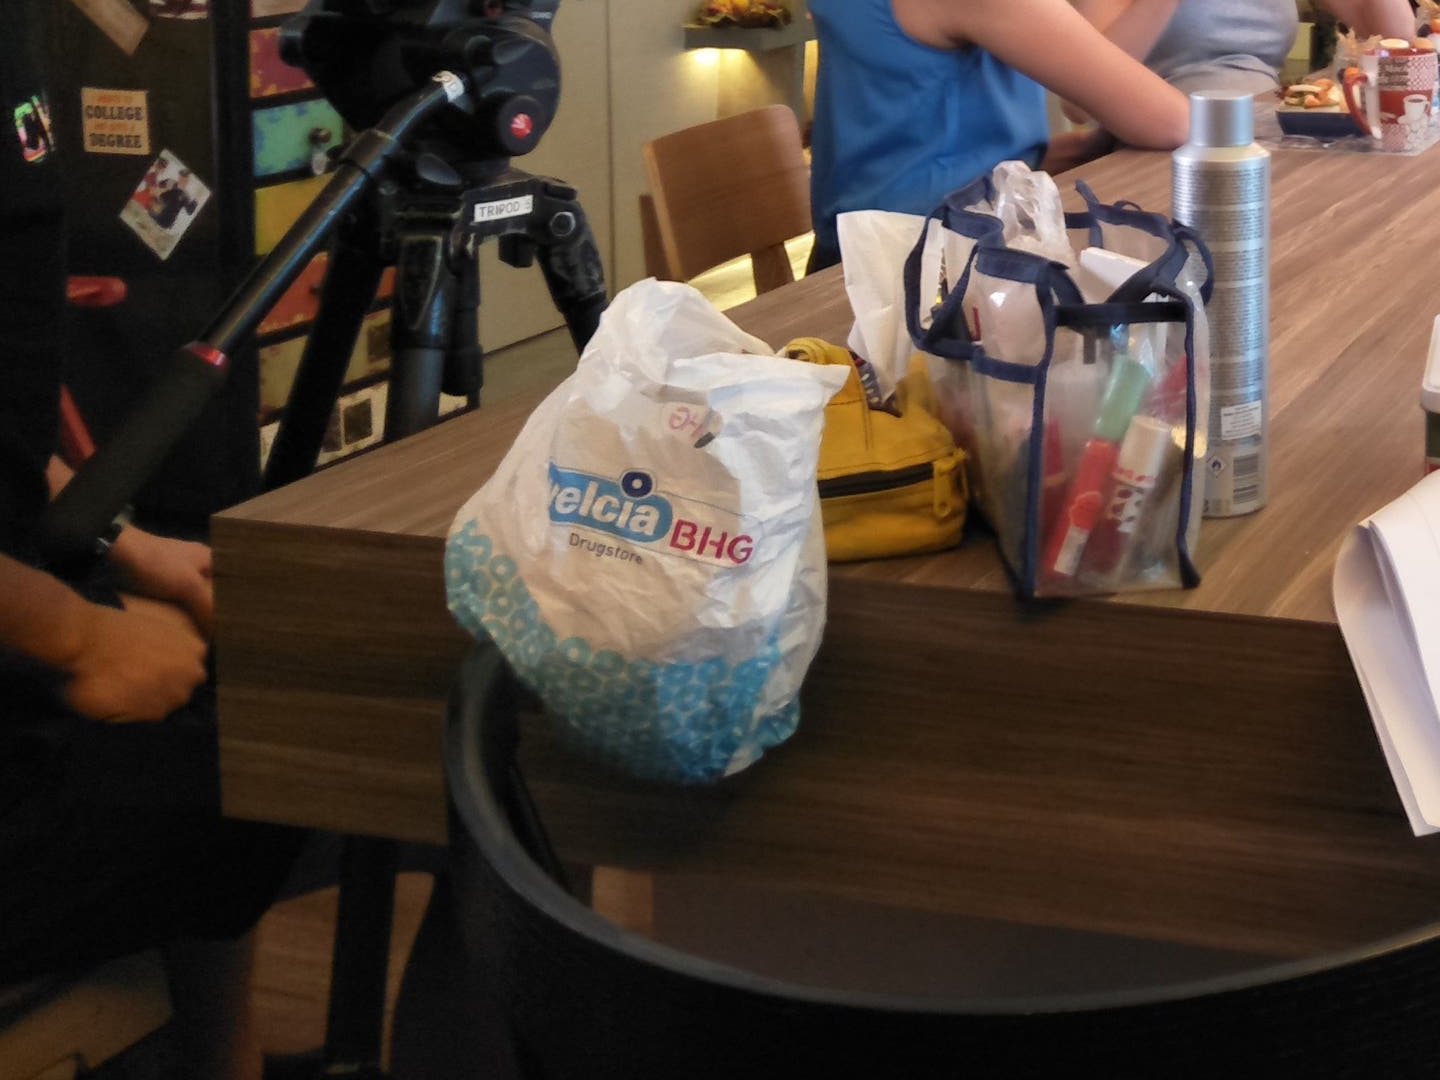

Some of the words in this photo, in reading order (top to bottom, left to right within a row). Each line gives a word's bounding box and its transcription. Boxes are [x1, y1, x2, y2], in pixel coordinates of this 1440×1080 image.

[86, 106, 142, 120] COLLEGE
[89, 133, 141, 148] DEGREE
[479, 201, 520, 218] TRIPOD
[568, 532, 644, 566] Drugstore
[669, 519, 754, 565] BHG
